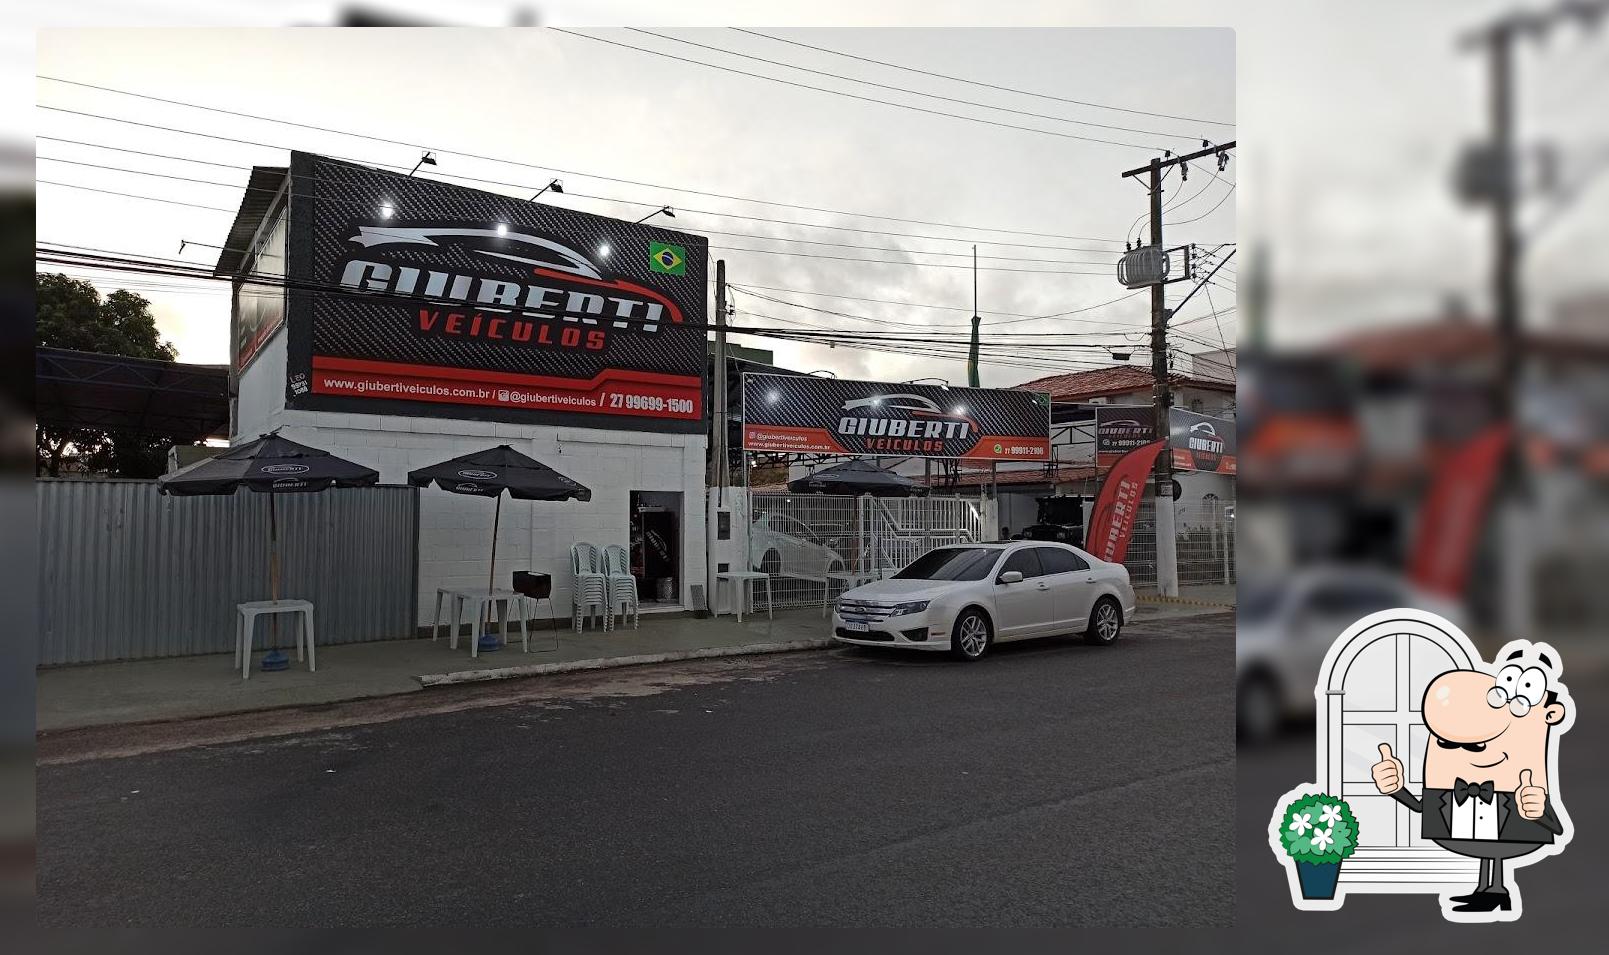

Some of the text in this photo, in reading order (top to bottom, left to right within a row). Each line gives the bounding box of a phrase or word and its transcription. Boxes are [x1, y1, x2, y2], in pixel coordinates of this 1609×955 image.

[339, 259, 664, 333] GIUBERTI
[418, 309, 606, 350] VEÍCULOS
[324, 379, 490, 399] www.giubertiveiculos.com.br
[510, 391, 596, 407] @giubertiveiculos
[609, 393, 624, 408] 27
[625, 394, 694, 414] 99699-1500
[839, 417, 970, 439] GIUBERTI
